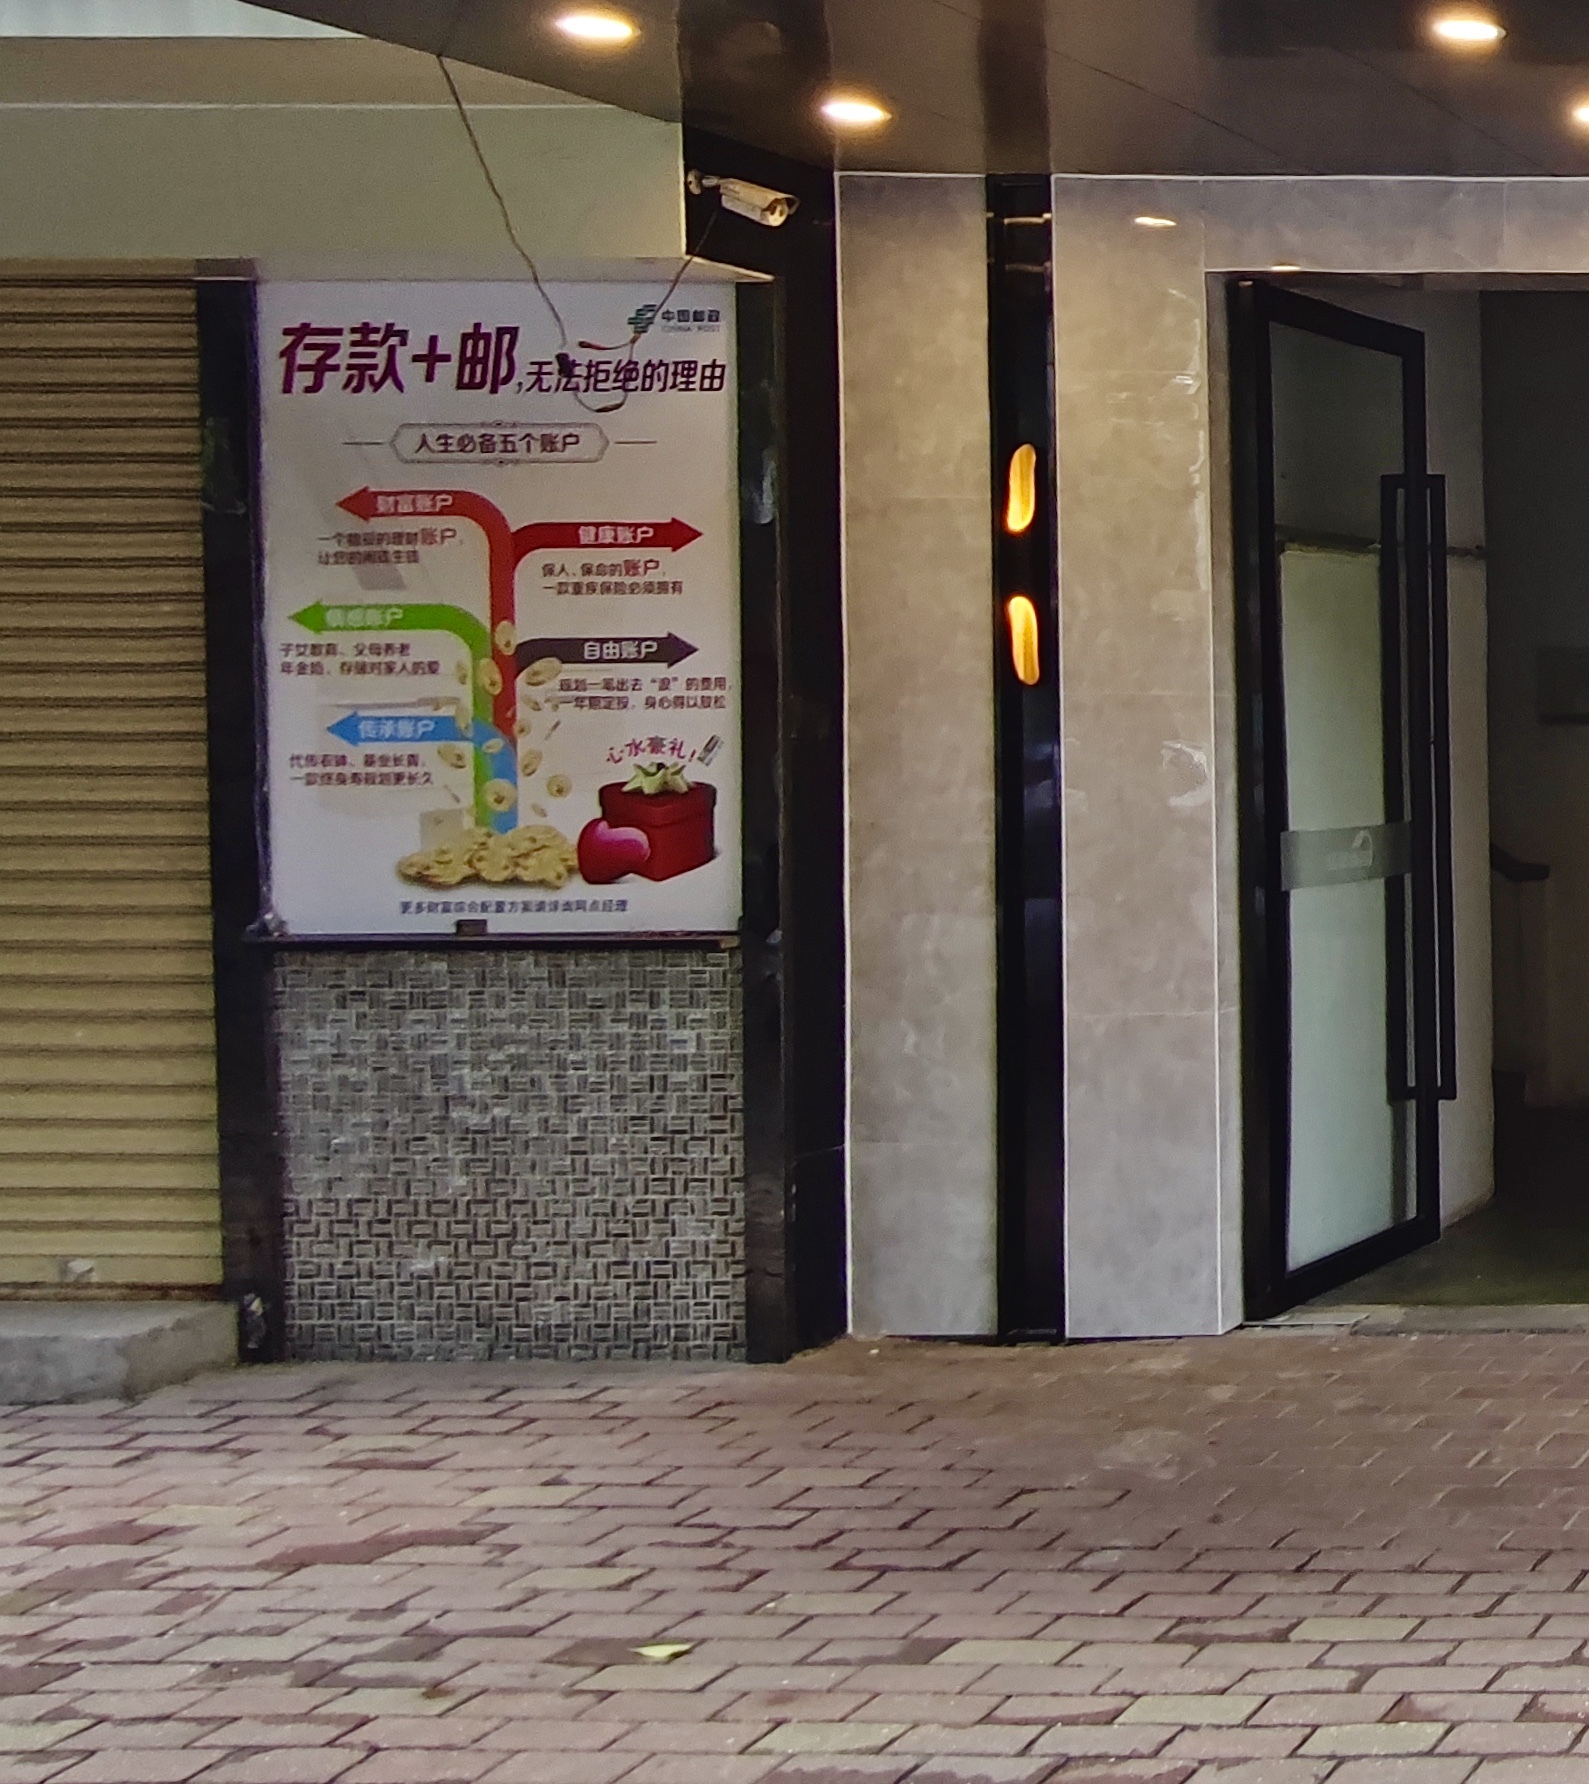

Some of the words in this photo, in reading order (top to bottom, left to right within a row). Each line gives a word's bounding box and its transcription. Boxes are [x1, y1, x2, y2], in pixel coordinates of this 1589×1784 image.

[414, 432, 581, 455] 人生必备五个账户
[578, 525, 655, 545] 健康账户
[583, 640, 658, 660] 自由账户
